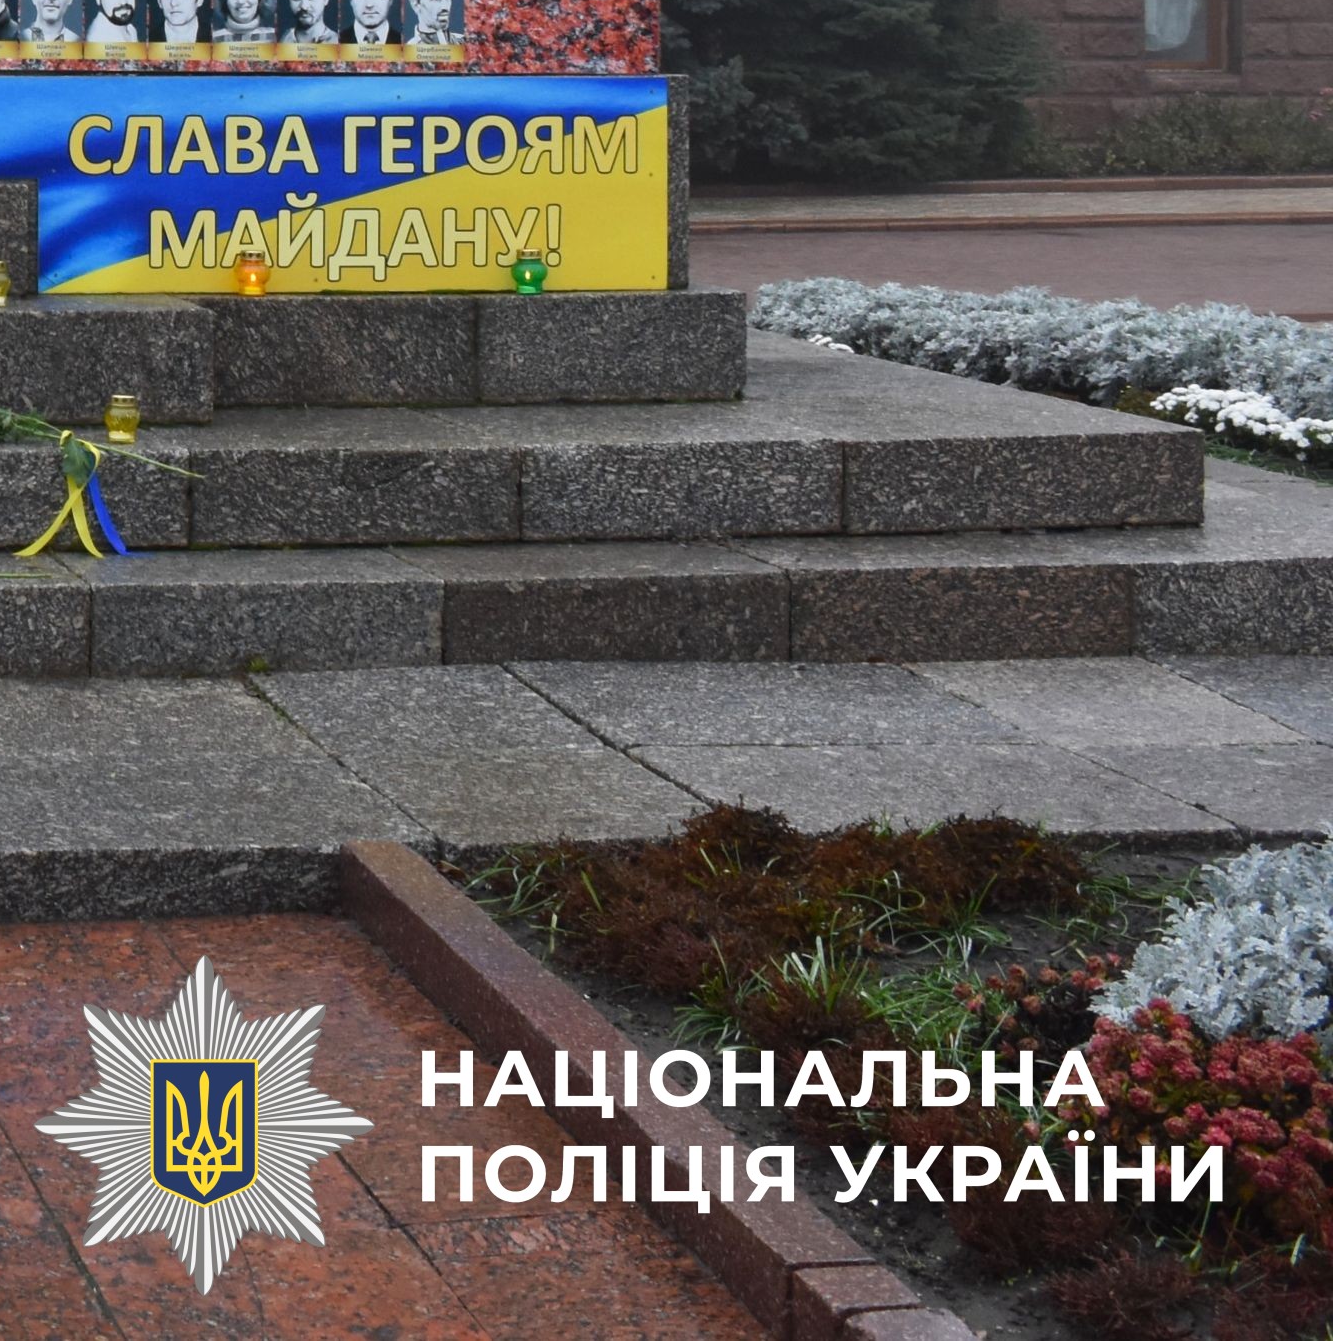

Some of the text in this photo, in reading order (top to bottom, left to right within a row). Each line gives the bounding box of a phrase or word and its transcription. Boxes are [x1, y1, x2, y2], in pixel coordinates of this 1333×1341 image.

[68, 114, 639, 175] СЛАВА ГЕРОЯМ
[148, 192, 563, 282] МАЙДАНУ!
